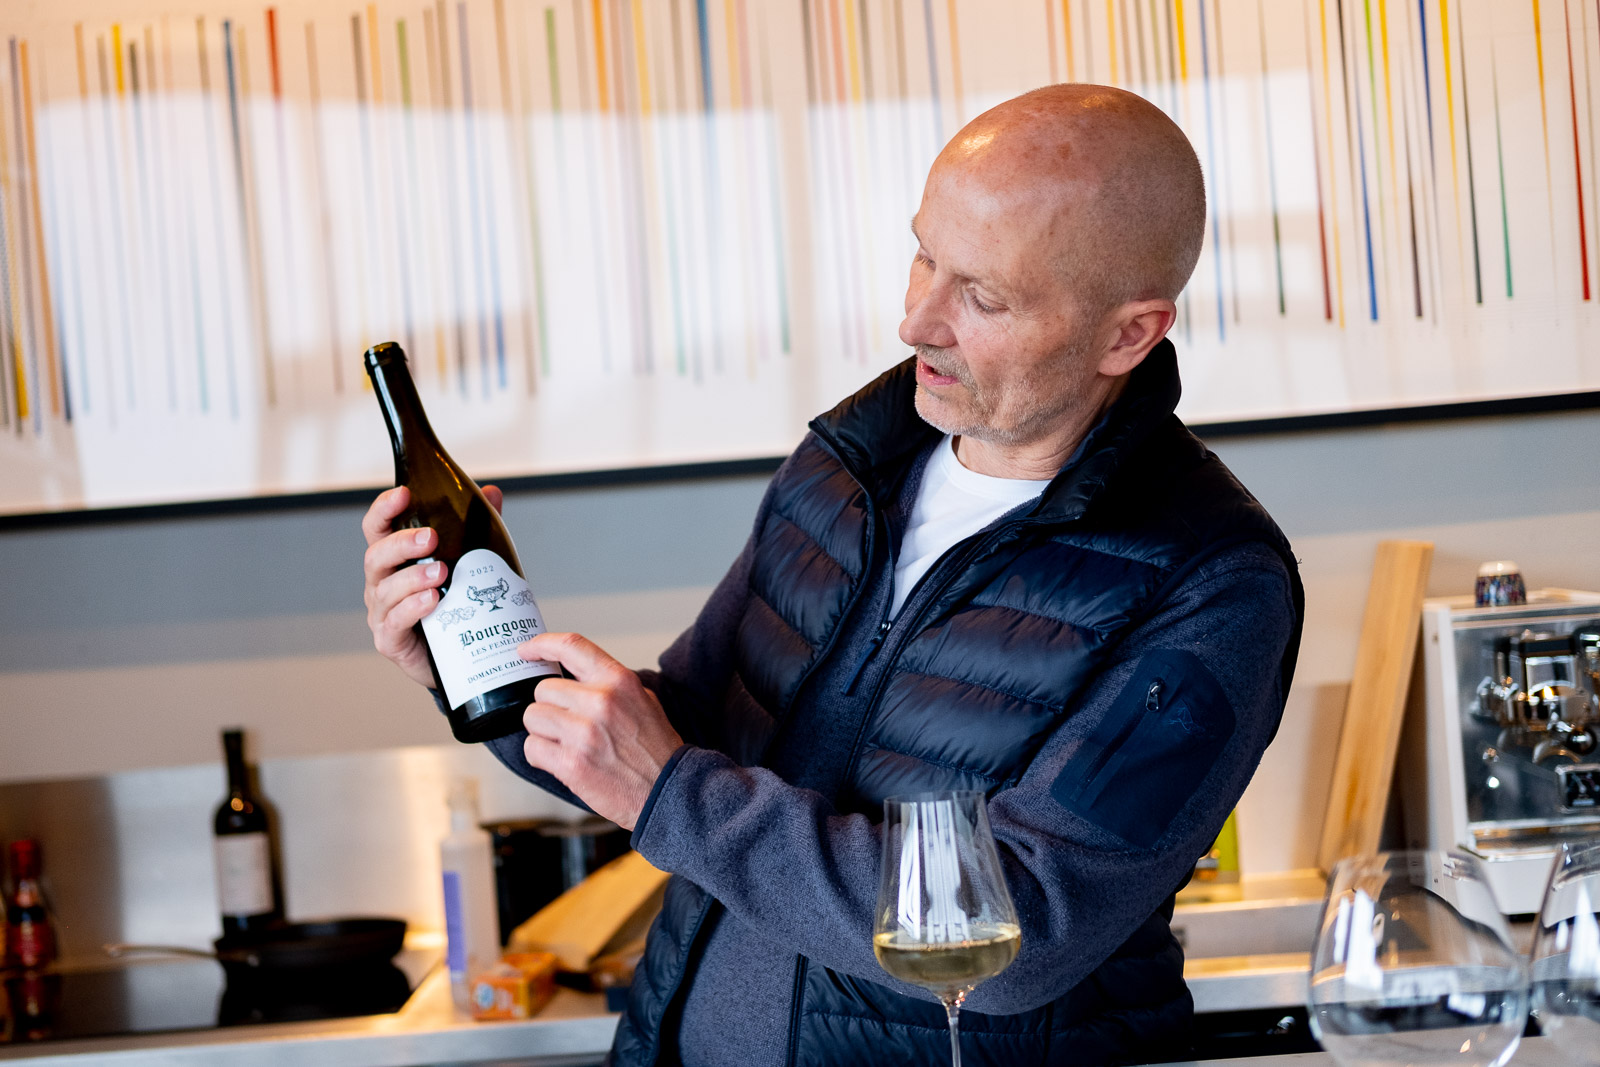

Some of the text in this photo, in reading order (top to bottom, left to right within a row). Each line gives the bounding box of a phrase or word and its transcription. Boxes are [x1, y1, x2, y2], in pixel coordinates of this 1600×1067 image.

[469, 564, 495, 577] 2022
[458, 617, 538, 649] Bourgogne
[470, 646, 487, 657] LES
[467, 665, 503, 684] DOMAINE
